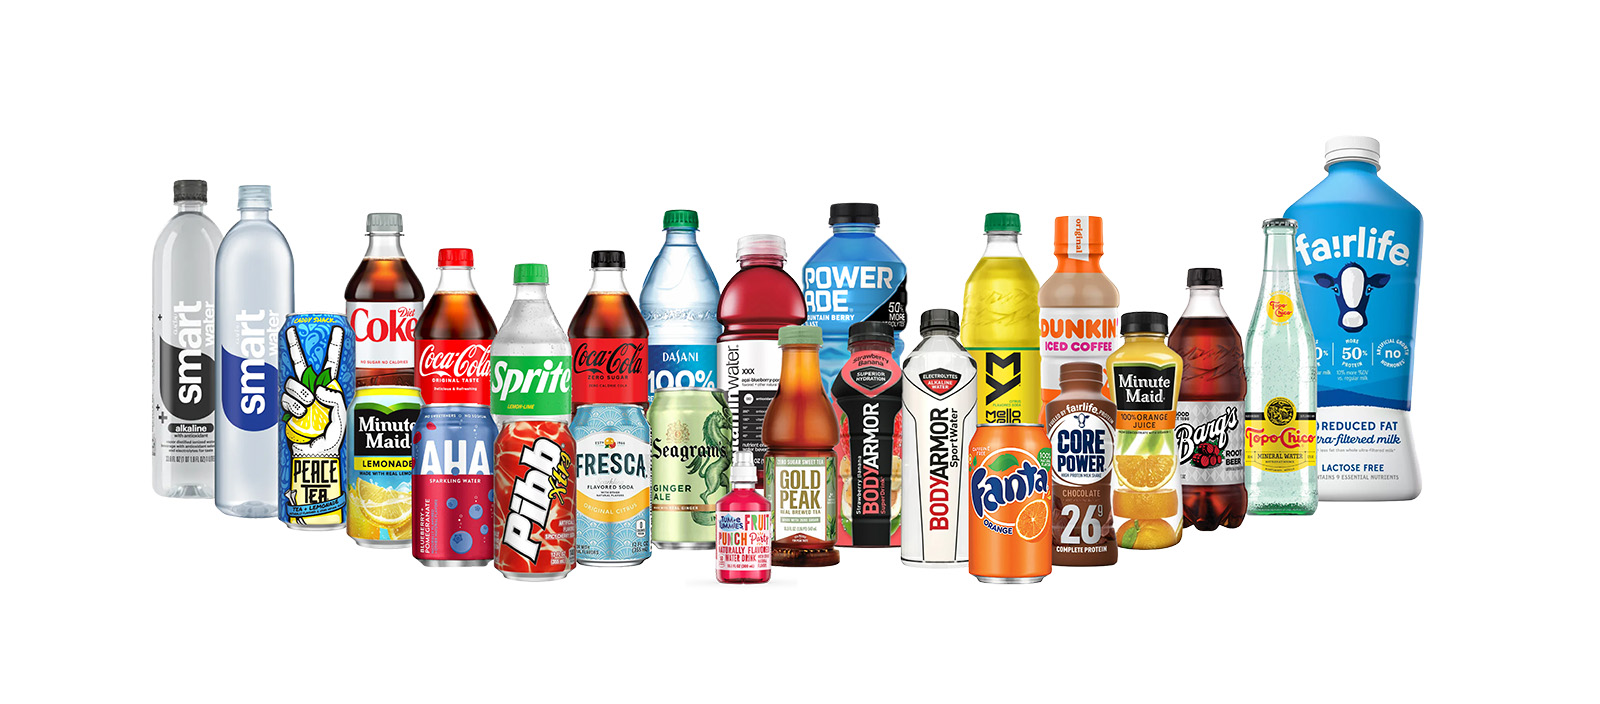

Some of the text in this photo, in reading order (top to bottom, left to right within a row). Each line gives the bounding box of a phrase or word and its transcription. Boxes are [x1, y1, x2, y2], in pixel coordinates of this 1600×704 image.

[1074, 218, 1083, 253] original
[805, 266, 893, 289] POWER
[805, 290, 848, 312] ADE
[397, 306, 416, 317] Diet
[889, 313, 905, 321] MORE
[203, 300, 215, 347] water
[350, 307, 418, 343] Coke
[267, 309, 280, 357] water
[174, 300, 203, 405] smart
[1045, 341, 1112, 351] ICED COFFEE
[1385, 349, 1401, 359] no
[235, 309, 266, 415] smart
[419, 344, 491, 378] Coca-Cola
[573, 343, 645, 375] Coca-Cola
[662, 350, 699, 364] DASANI
[491, 359, 571, 401] Sprite
[1118, 374, 1171, 388] Minute
[1125, 388, 1163, 403] Maid
[175, 424, 208, 432] alkaline
[358, 416, 417, 433] Minute
[1133, 421, 1156, 429] JUICE
[1321, 421, 1398, 431] REDUCED FAT
[365, 432, 412, 449] Maid
[1057, 429, 1106, 454] CORE
[1174, 406, 1239, 465] Barq's
[1245, 427, 1316, 449] Topo Chico
[1316, 433, 1402, 447] tra-filtered milk
[420, 439, 491, 475] AHA
[652, 438, 727, 462] Seagram's
[863, 402, 879, 515] BODYARMOR
[1225, 449, 1242, 457] ROOT
[362, 460, 413, 468] LEMONADE
[576, 452, 646, 479] FRESCA
[929, 407, 949, 531] BODYARMOR
[1057, 455, 1105, 473] POWER
[1225, 458, 1242, 466] BEER
[1321, 464, 1385, 472] LACTOSE FREE
[294, 460, 338, 483] PEACE
[780, 469, 821, 489] GOLD
[300, 484, 332, 503] TEA
[653, 484, 692, 492] GINGER
[971, 461, 1048, 518] Fanta
[1062, 489, 1101, 497] CHOCOLATE
[309, 499, 339, 511] LEMONADE
[653, 493, 671, 501] ALE
[780, 490, 821, 509] PEAK
[583, 502, 638, 515] ORIGINAL CITRUS
[745, 514, 769, 531] FRUIT
[983, 519, 1013, 535] ORANGE
[719, 532, 769, 546] PUNCH Party
[725, 554, 740, 562] WATER
[741, 554, 757, 562] DRINK
